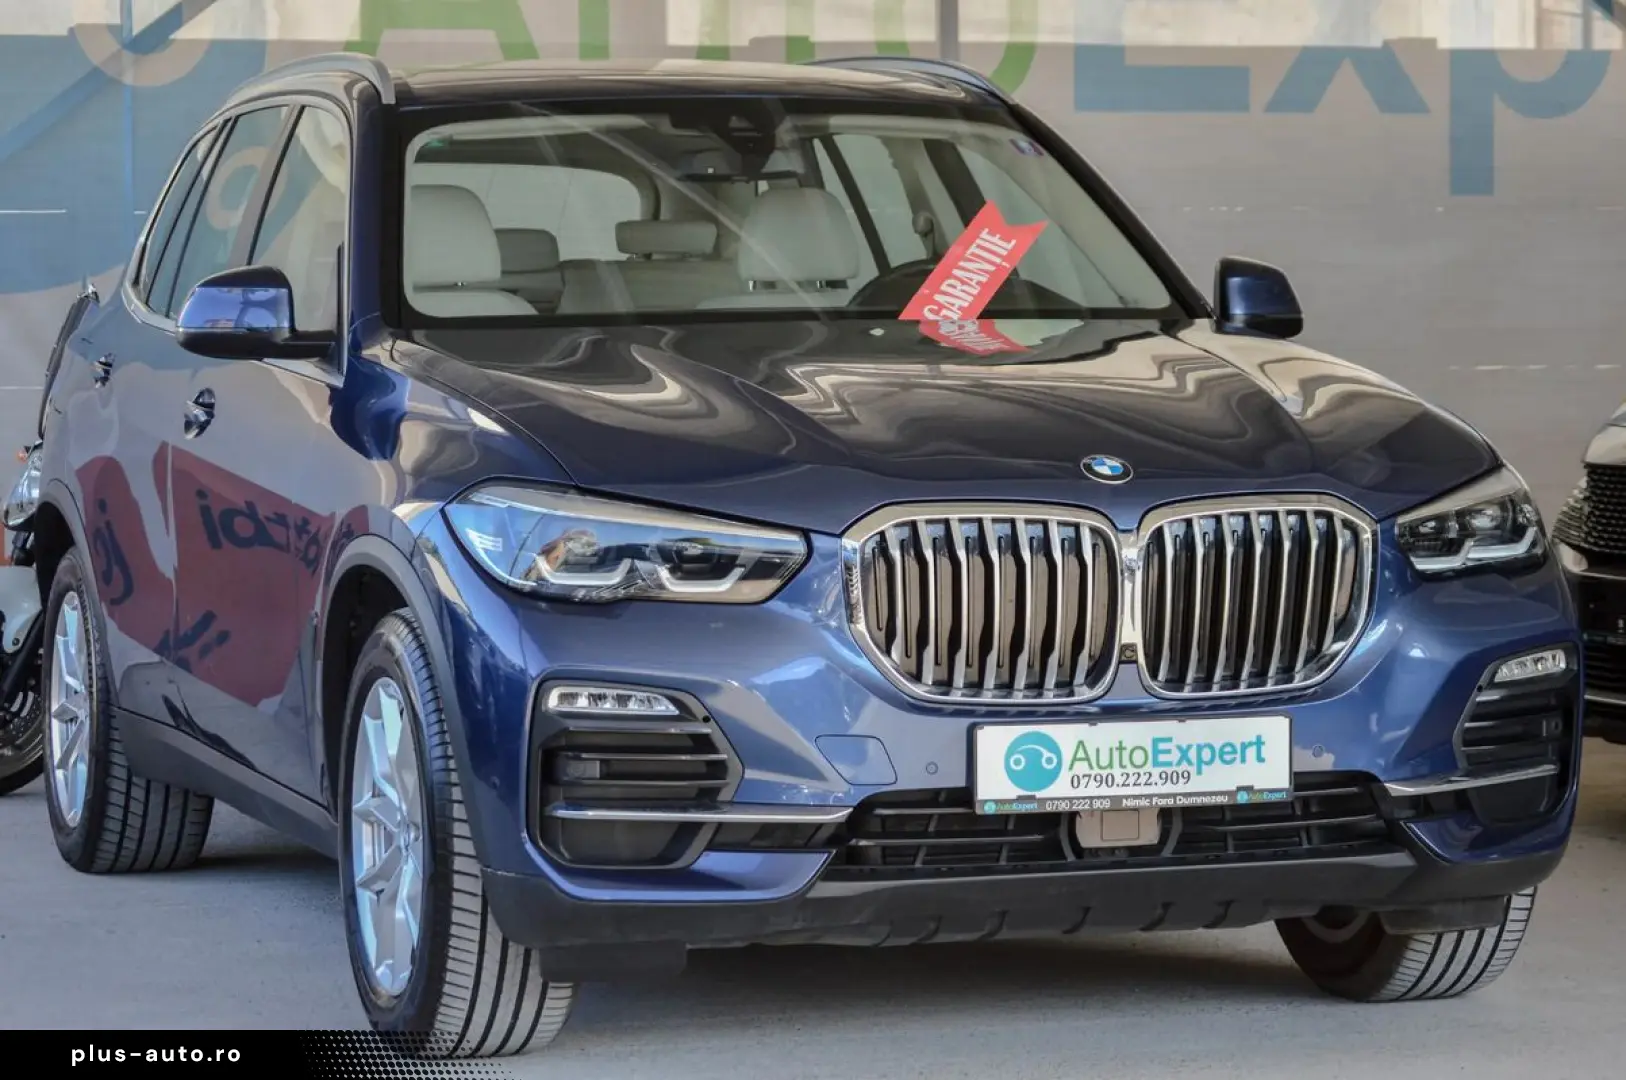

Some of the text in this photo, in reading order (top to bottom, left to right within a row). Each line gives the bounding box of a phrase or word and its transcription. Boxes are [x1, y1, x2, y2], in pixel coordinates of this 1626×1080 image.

[1068, 734, 1266, 776] AutoExpert
[1070, 770, 1191, 789] 0790.222.909
[1046, 800, 1070, 810] 0790
[1072, 799, 1090, 809] 222
[1092, 798, 1111, 808] 909
[1122, 797, 1150, 807] Nimic
[1152, 797, 1174, 805] Fara
[1176, 794, 1228, 804] Dumnezeu
